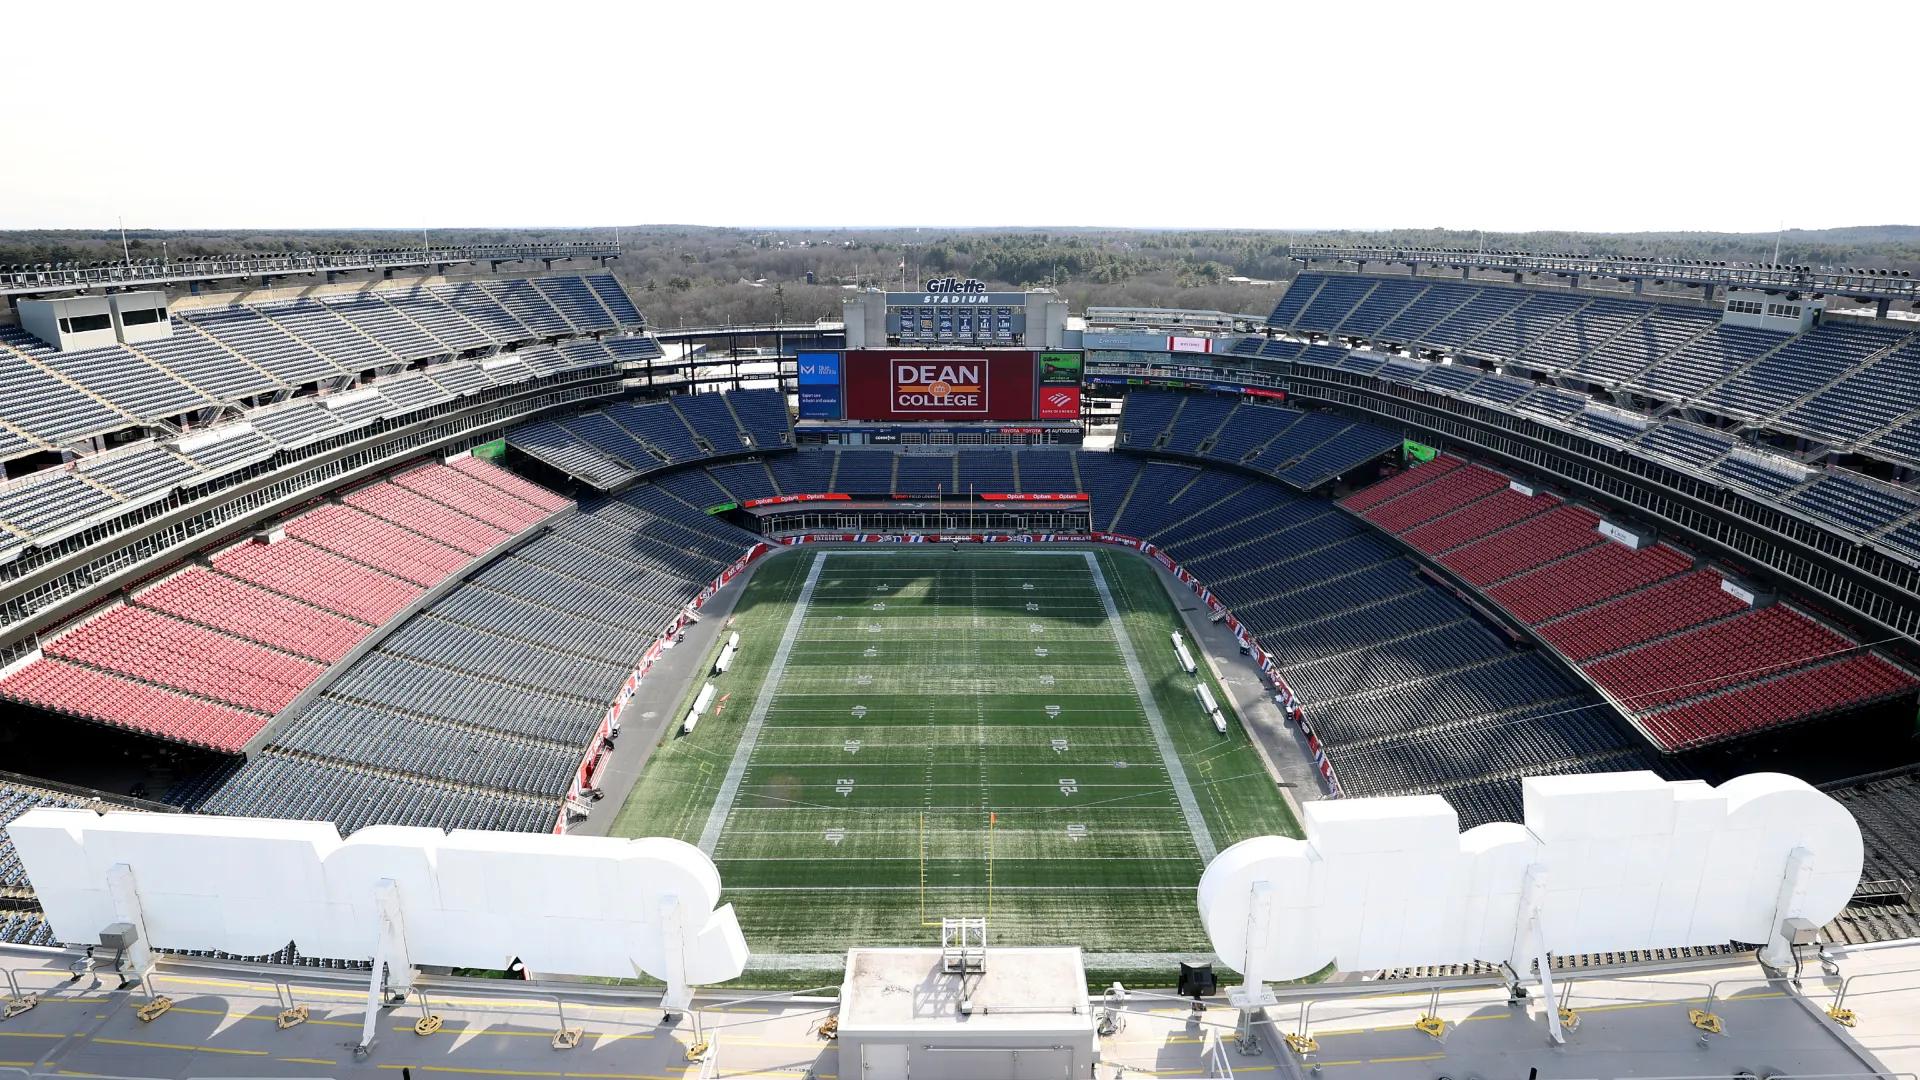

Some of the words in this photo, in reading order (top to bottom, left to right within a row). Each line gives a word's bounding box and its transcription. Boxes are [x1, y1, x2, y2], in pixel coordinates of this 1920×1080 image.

[926, 278, 986, 293] Gillette
[924, 296, 988, 304] STADIUM
[898, 366, 978, 384] DEAN
[898, 394, 978, 406] COLLEGE
[836, 779, 854, 792] 20
[1059, 778, 1078, 792] 20
